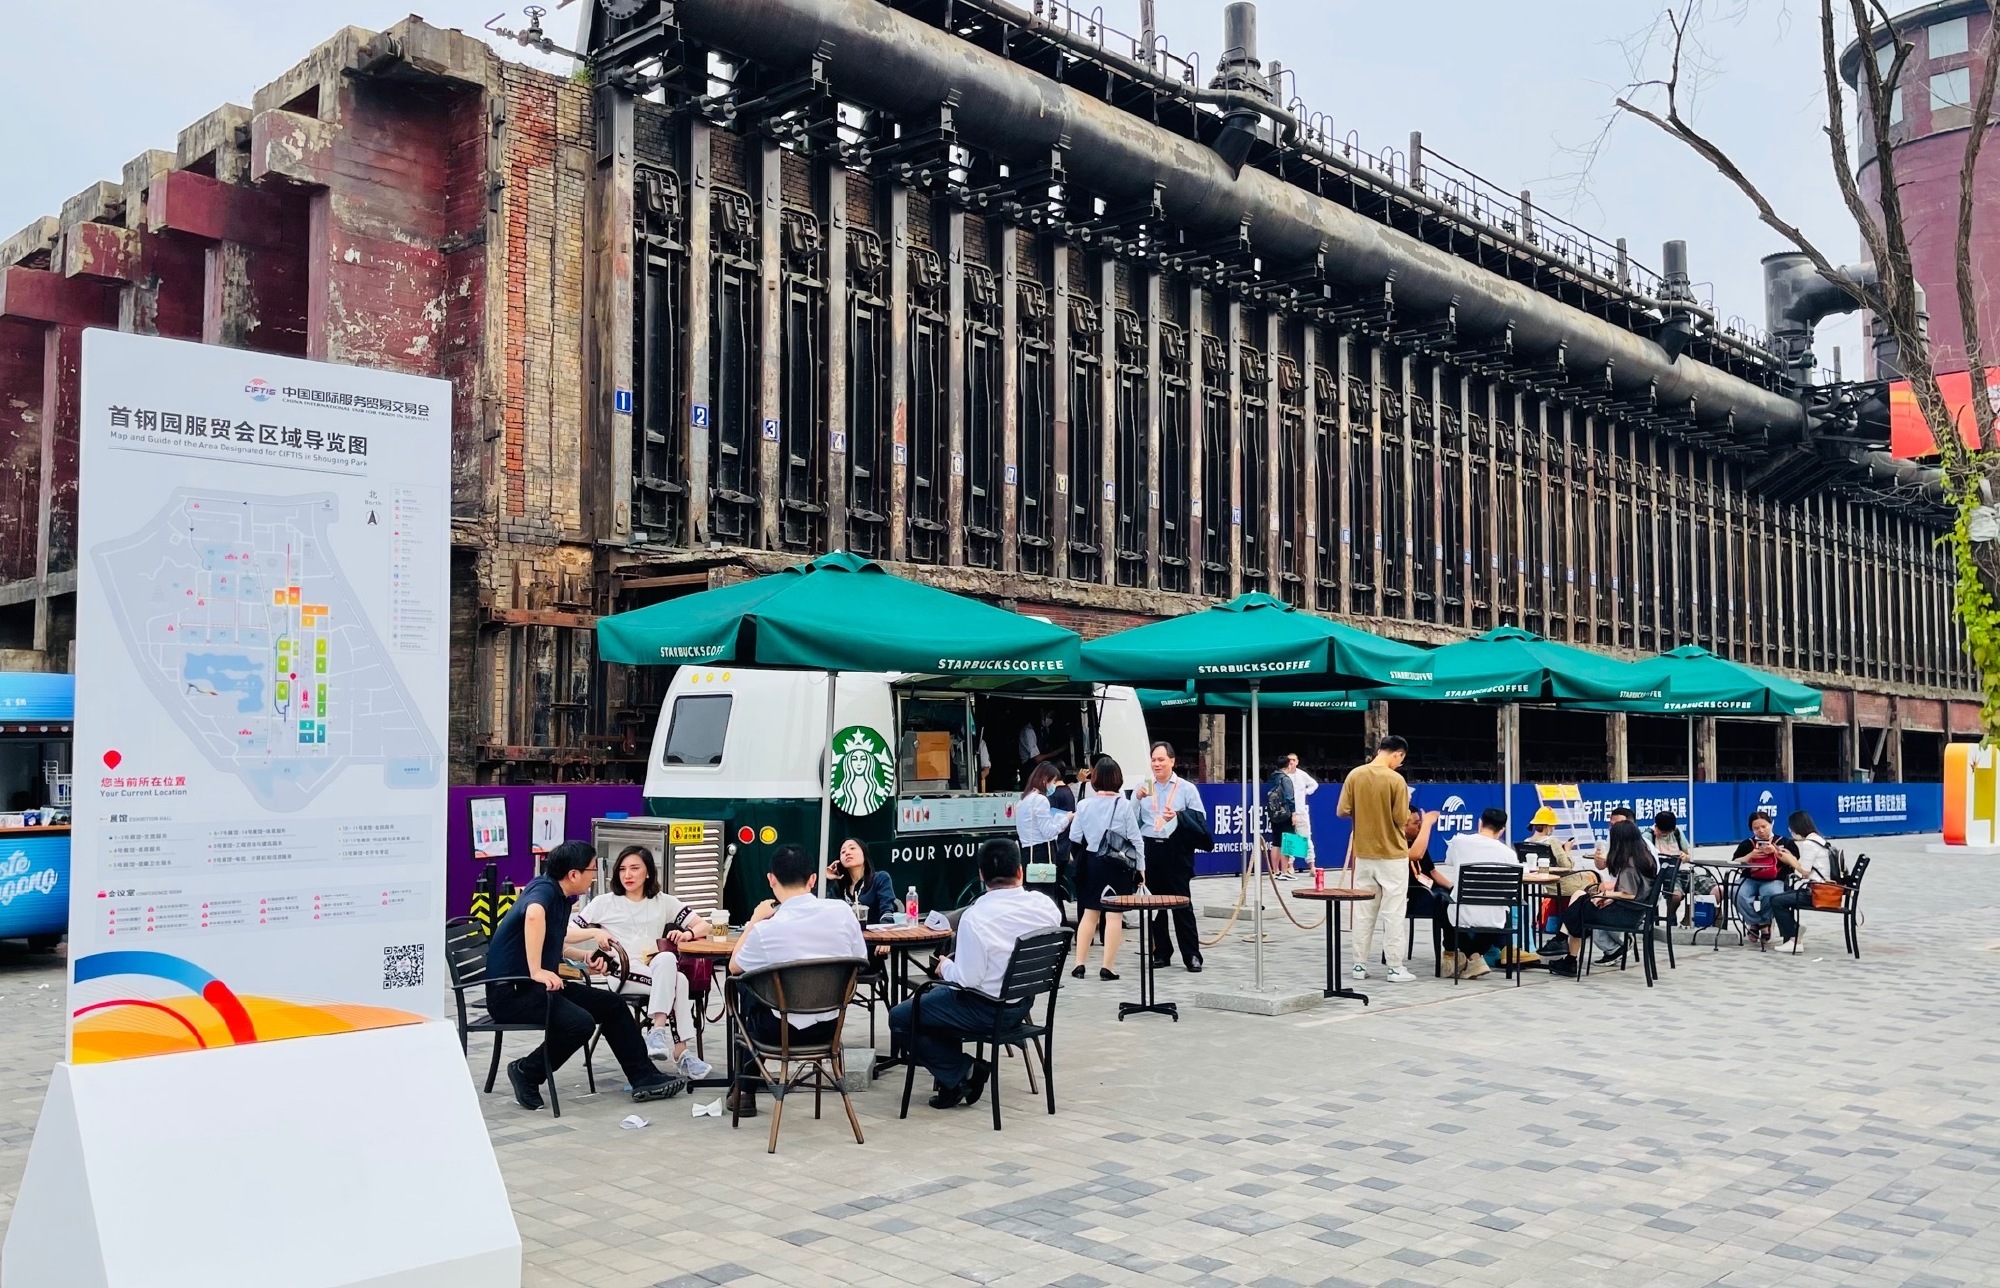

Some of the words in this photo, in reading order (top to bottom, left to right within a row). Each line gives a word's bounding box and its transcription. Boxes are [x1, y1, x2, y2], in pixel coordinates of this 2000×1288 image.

[244, 385, 276, 396] CIFTIS
[282, 386, 430, 417] 中国国际服务贸易交易会
[304, 401, 350, 411] INTERNATIONAL
[620, 392, 626, 410] 1
[696, 408, 705, 424] 2
[108, 404, 368, 456] 首钢园服贸会区域导览图
[767, 421, 776, 438] 3
[110, 431, 128, 440] Map
[148, 436, 172, 444] Guide
[198, 442, 218, 450] Area
[220, 444, 263, 454] Designated
[278, 450, 303, 460] CIFTIS
[834, 436, 842, 450] 4
[896, 446, 904, 462] 5
[1007, 468, 1014, 482] 7
[369, 490, 378, 500] 北
[101, 776, 186, 788] 您当前所在位置
[110, 814, 128, 823] 展馆
[1438, 814, 1474, 832] CIFTIS
[892, 846, 936, 863] POUR
[944, 842, 984, 859] YOU
[108, 889, 136, 898] 会议室
